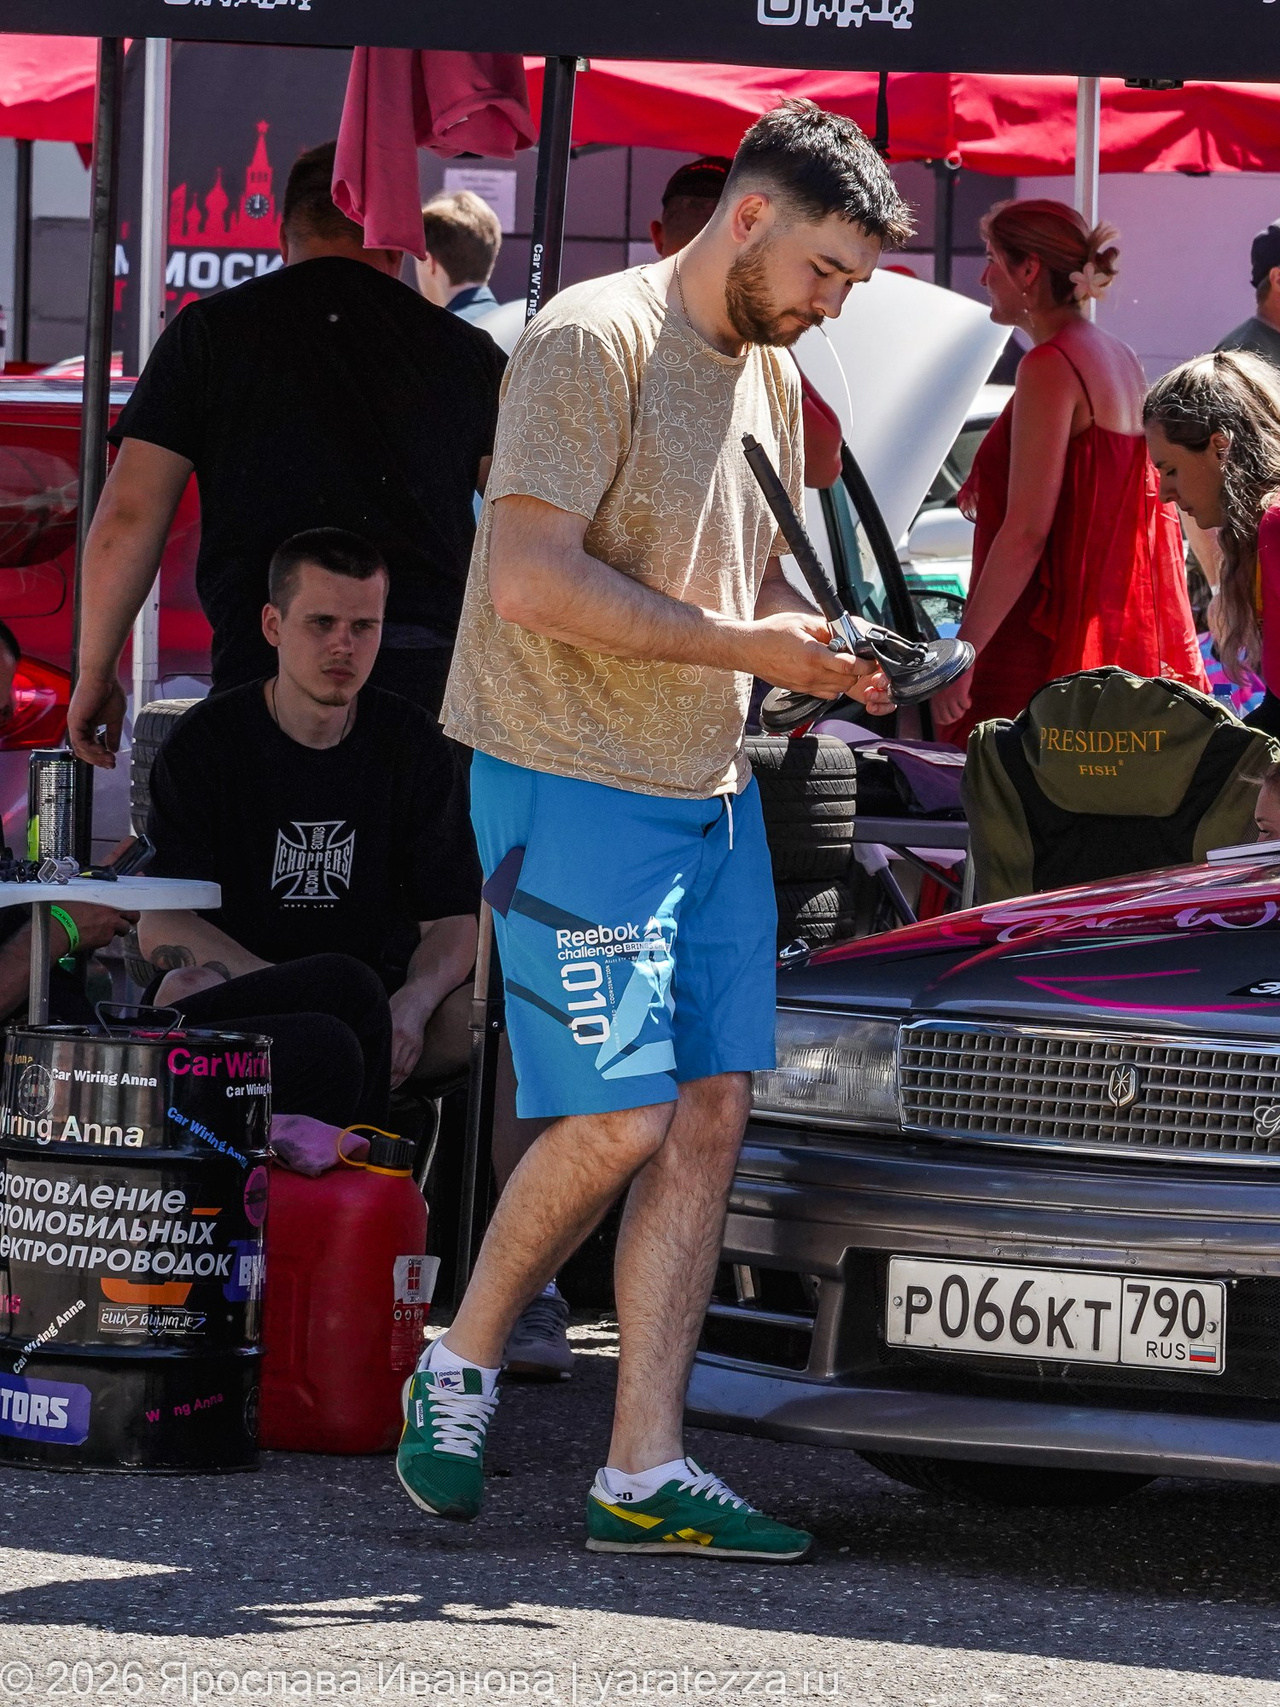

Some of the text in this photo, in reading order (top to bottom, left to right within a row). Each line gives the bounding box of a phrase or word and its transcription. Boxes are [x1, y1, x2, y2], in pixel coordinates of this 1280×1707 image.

[1040, 727, 1167, 753] PRESIDENT
[277, 842, 351, 877] CHOPPERS
[555, 922, 641, 949] Reebok
[557, 943, 623, 960] challenge
[560, 961, 611, 1046] 010
[167, 1047, 222, 1077] Car
[51, 1068, 158, 1087] Car Wiring Anna
[226, 1085, 245, 1098] Car
[60, 1115, 144, 1148] Anna
[167, 1107, 189, 1126] Car
[190, 1119, 228, 1153] Wiring
[24, 1322, 56, 1355] Wiring
[55, 1299, 87, 1328] Anna
[905, 1274, 1112, 1351] Р066КТ
[1126, 1284, 1206, 1340] 790
[1146, 1340, 1187, 1361] RUS
[193, 1392, 224, 1411] Anna
